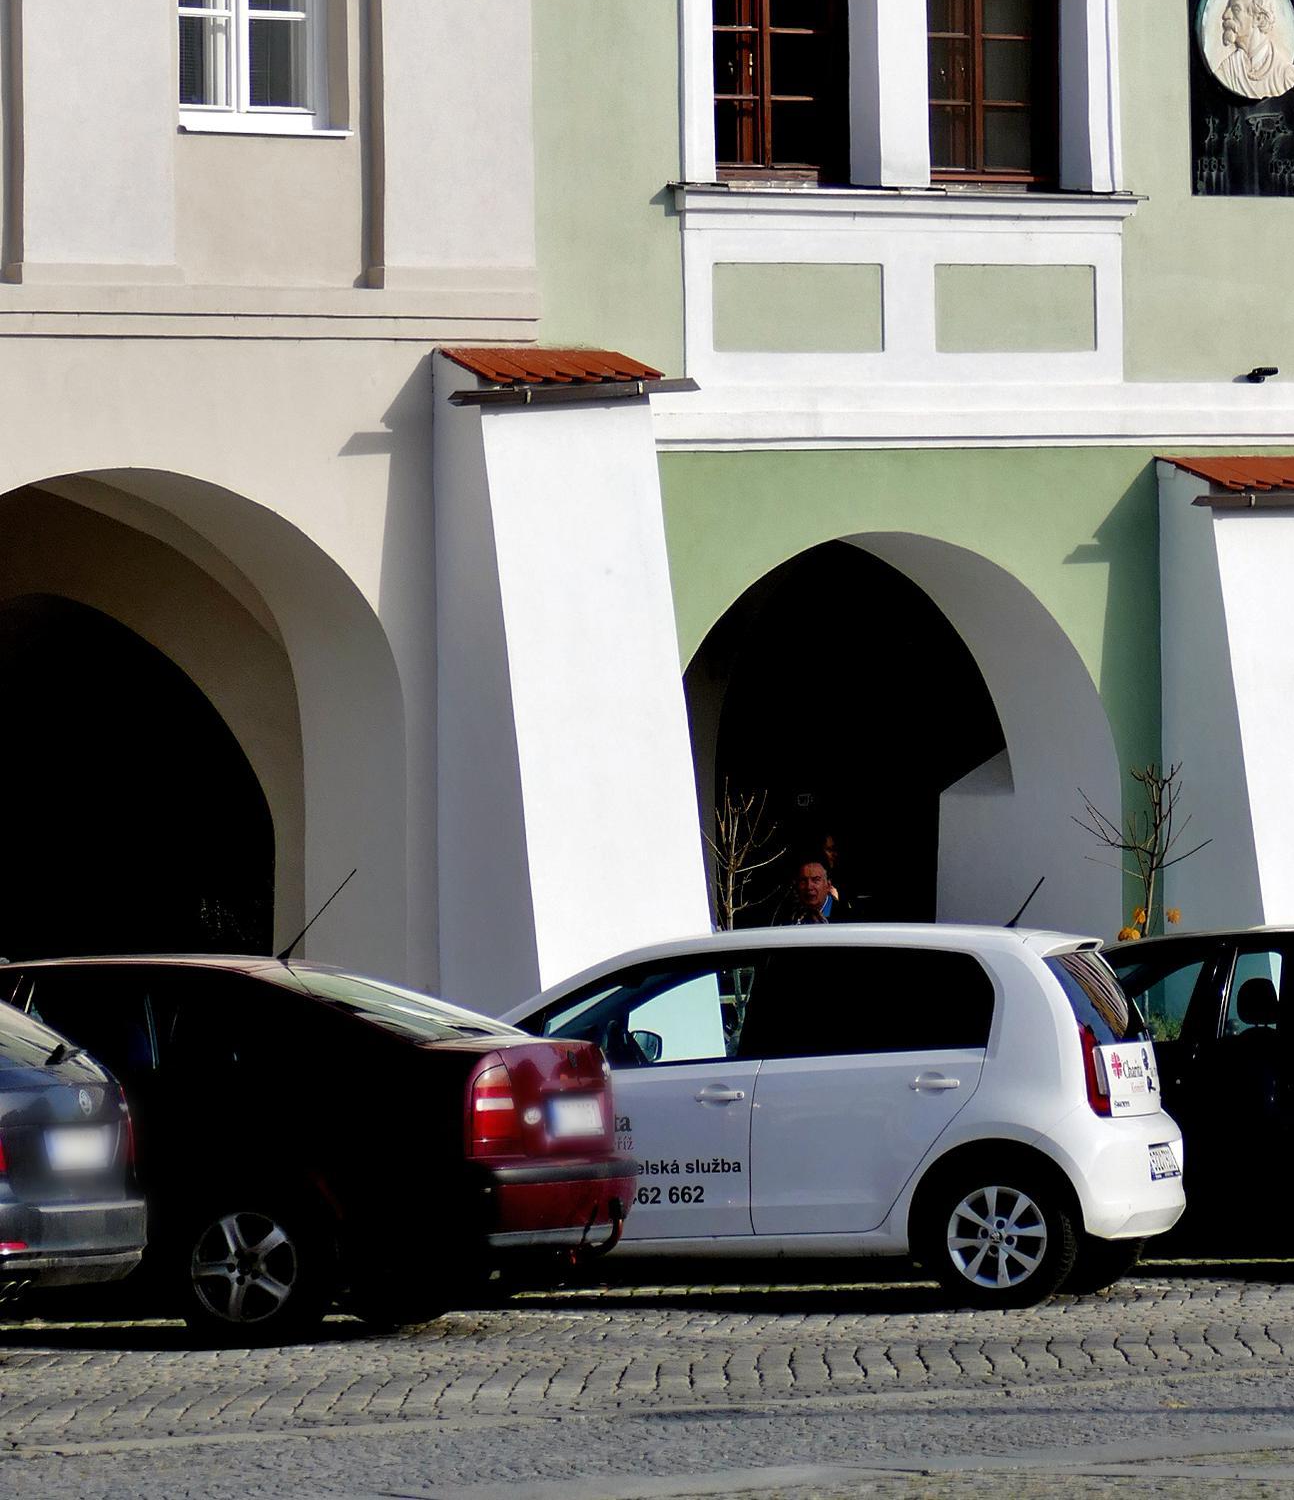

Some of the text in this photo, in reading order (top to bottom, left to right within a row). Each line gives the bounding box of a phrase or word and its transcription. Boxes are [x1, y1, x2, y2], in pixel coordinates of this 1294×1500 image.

[637, 1157, 743, 1176] elská služba
[632, 1185, 705, 1205] 62 662
